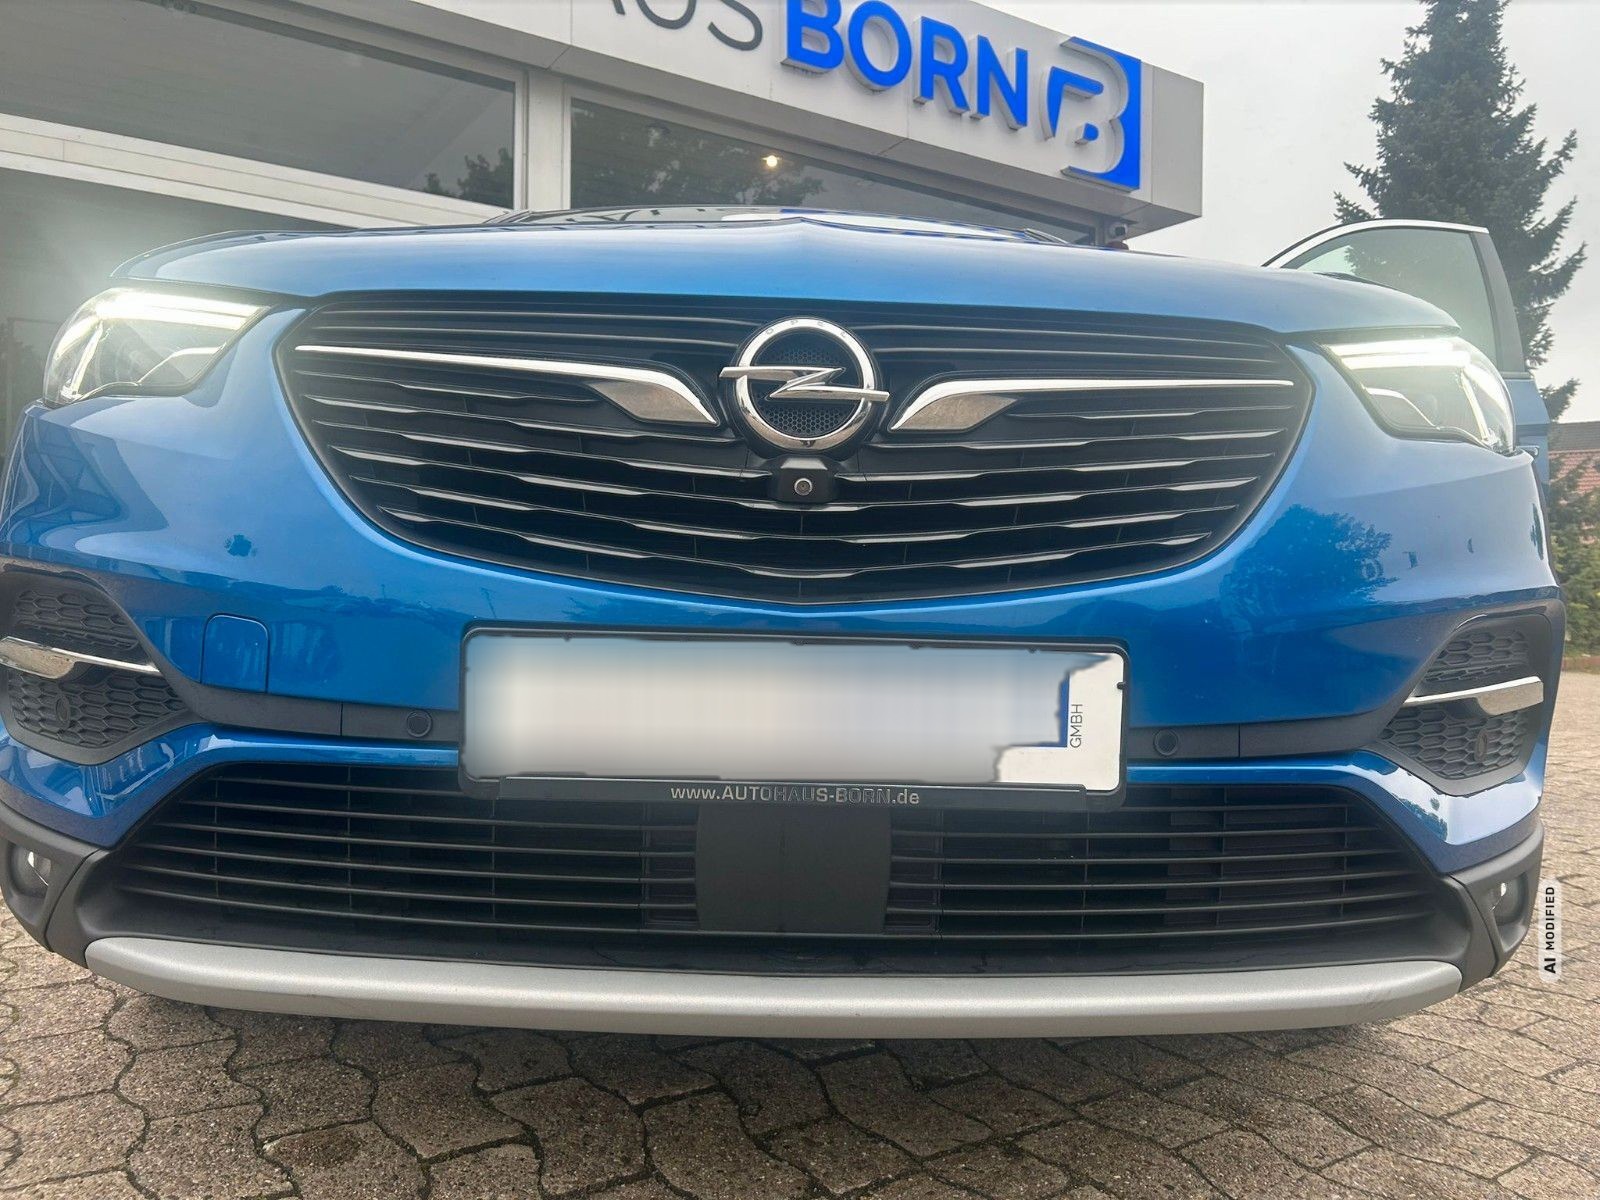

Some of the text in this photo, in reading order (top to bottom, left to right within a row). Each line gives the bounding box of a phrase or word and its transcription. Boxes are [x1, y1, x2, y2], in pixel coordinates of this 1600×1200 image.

[784, 0, 1029, 129] BORN
[1069, 703, 1083, 749] GMBH
[670, 784, 920, 805] www.AUTOHAUS-BORN.de
